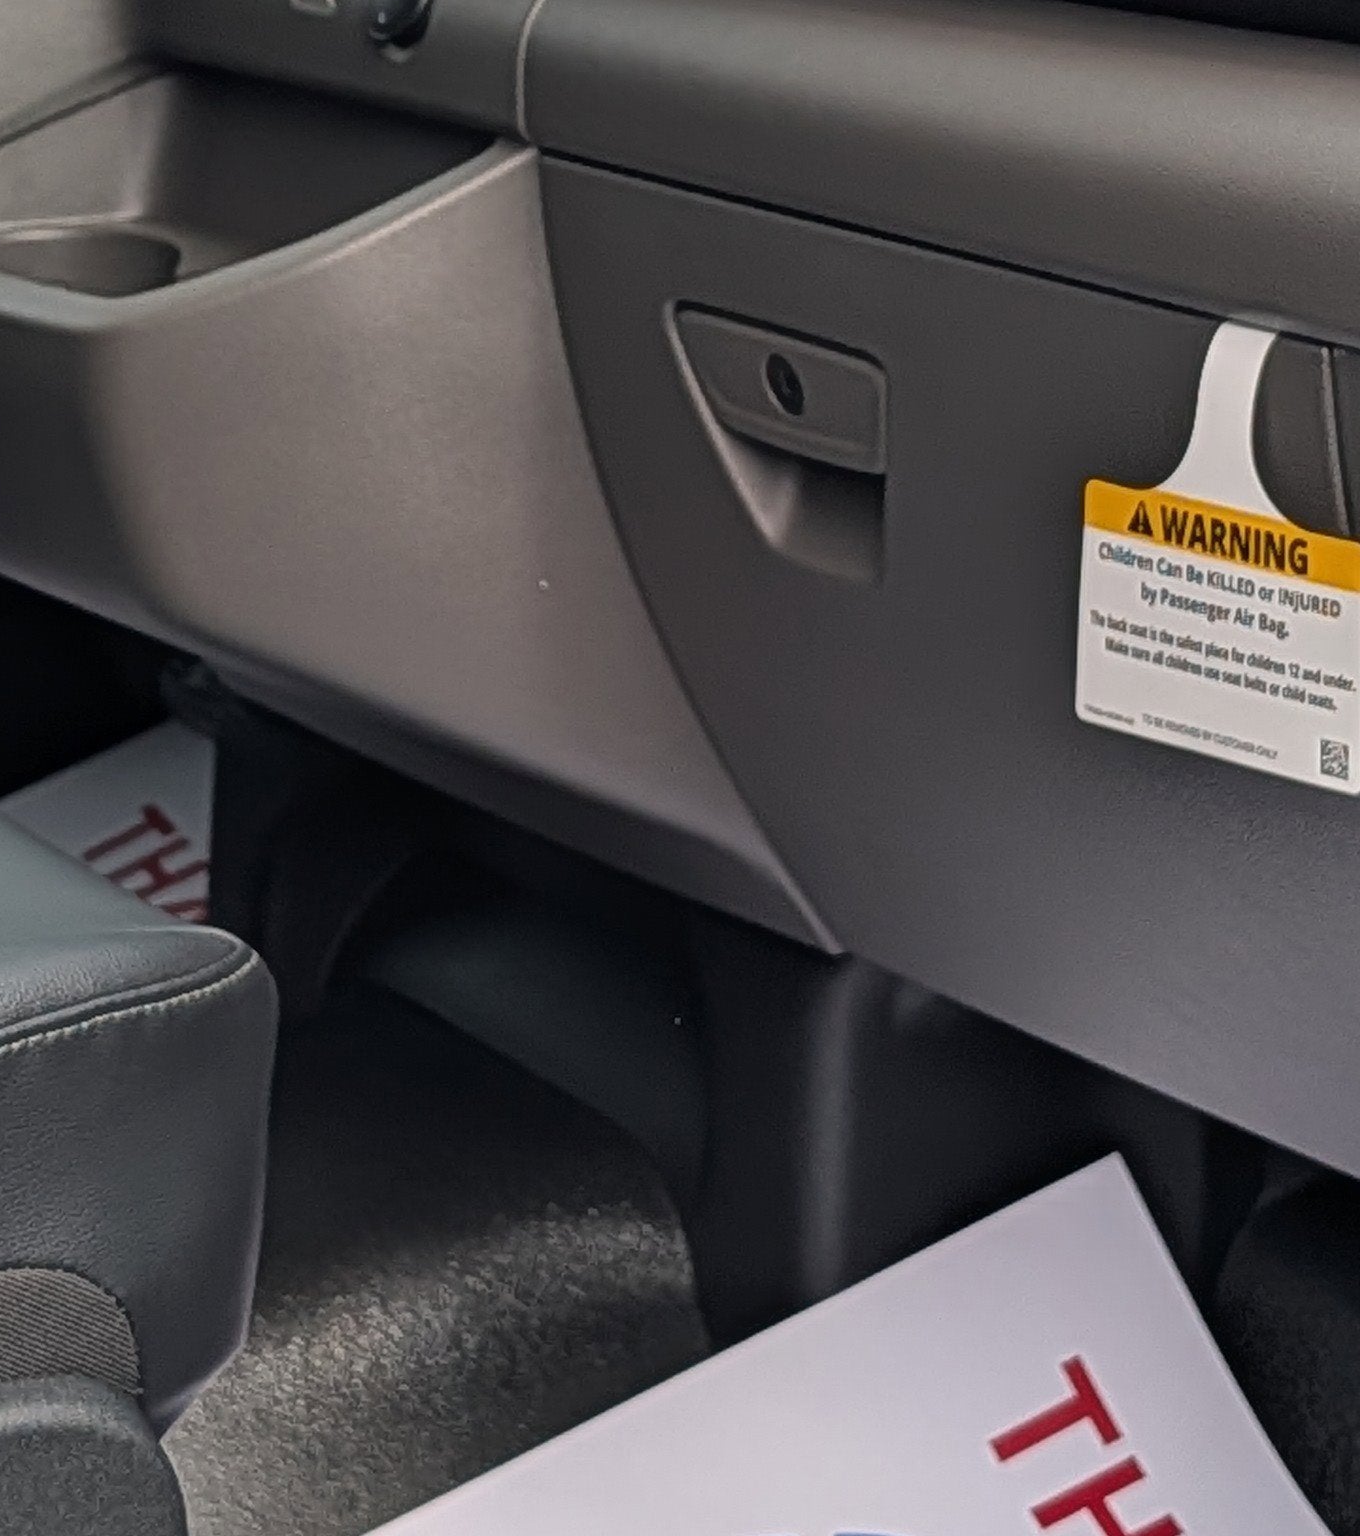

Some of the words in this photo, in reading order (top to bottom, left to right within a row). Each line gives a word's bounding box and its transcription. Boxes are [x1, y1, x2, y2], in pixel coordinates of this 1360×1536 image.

[1159, 504, 1309, 576] WARNING
[1098, 541, 1154, 572] Children
[1156, 557, 1183, 579] Can
[1186, 564, 1205, 585] Be
[1207, 569, 1256, 598] KILLED
[1258, 586, 1275, 602] or
[1278, 587, 1342, 619] INJURED
[1141, 582, 1158, 607] by
[1160, 587, 1231, 623] Passenger
[1233, 607, 1256, 628] Air
[1258, 613, 1290, 640] Bag.
[1089, 609, 1105, 627] The
[1107, 613, 1127, 633] back
[1128, 624, 1148, 638] seat
[1149, 624, 1158, 641] is
[1159, 629, 1174, 646] the
[1176, 635, 1203, 653] safest
[1205, 642, 1229, 661] place
[1246, 653, 1286, 675] children
[1288, 663, 1300, 679] 12
[1302, 668, 1322, 684] and
[1105, 636, 1129, 656] Make
[1130, 646, 1151, 662] sure
[1152, 650, 1164, 665] all
[1165, 654, 1202, 676] children
[1204, 666, 1221, 681] use
[1222, 670, 1242, 687] seat
[1243, 673, 1267, 694] belts
[1269, 683, 1280, 697] or
[1282, 684, 1306, 704] child
